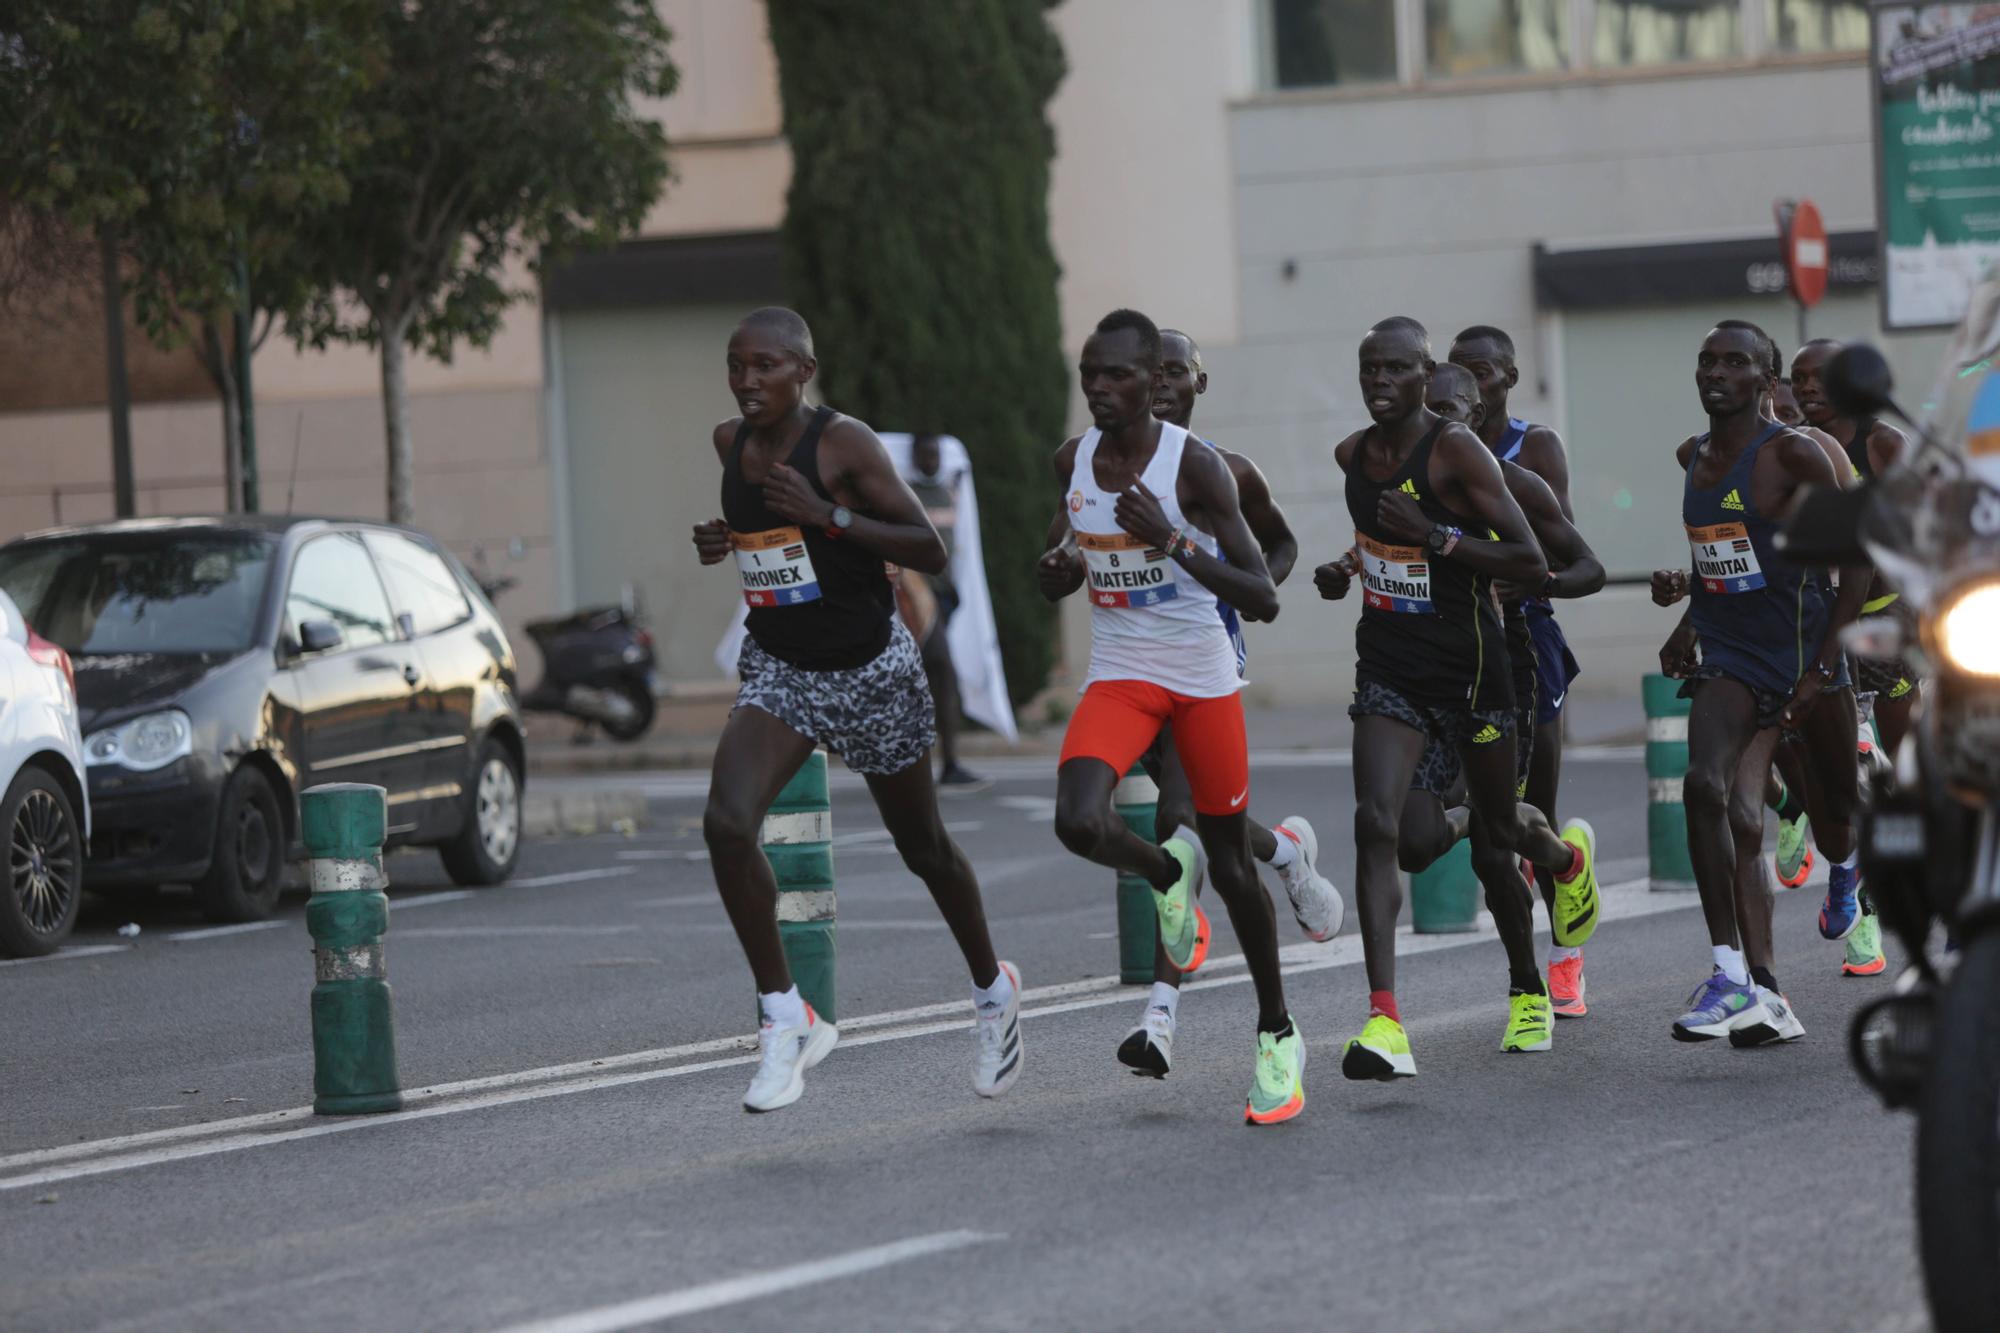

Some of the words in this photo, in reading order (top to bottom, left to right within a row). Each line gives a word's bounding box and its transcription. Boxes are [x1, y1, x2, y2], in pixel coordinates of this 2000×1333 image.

[1085, 498, 1097, 507] NN
[1721, 502, 1745, 511] adidas
[1702, 545, 1718, 558] 14
[752, 553, 762, 567] 1
[1109, 553, 1120, 568] 8
[1380, 560, 1388, 575] 2
[1698, 557, 1750, 576] KIMUTAI
[742, 565, 804, 587] RHONEX
[1091, 567, 1164, 588] MATEIKO
[1364, 569, 1428, 598] PHILEMON
